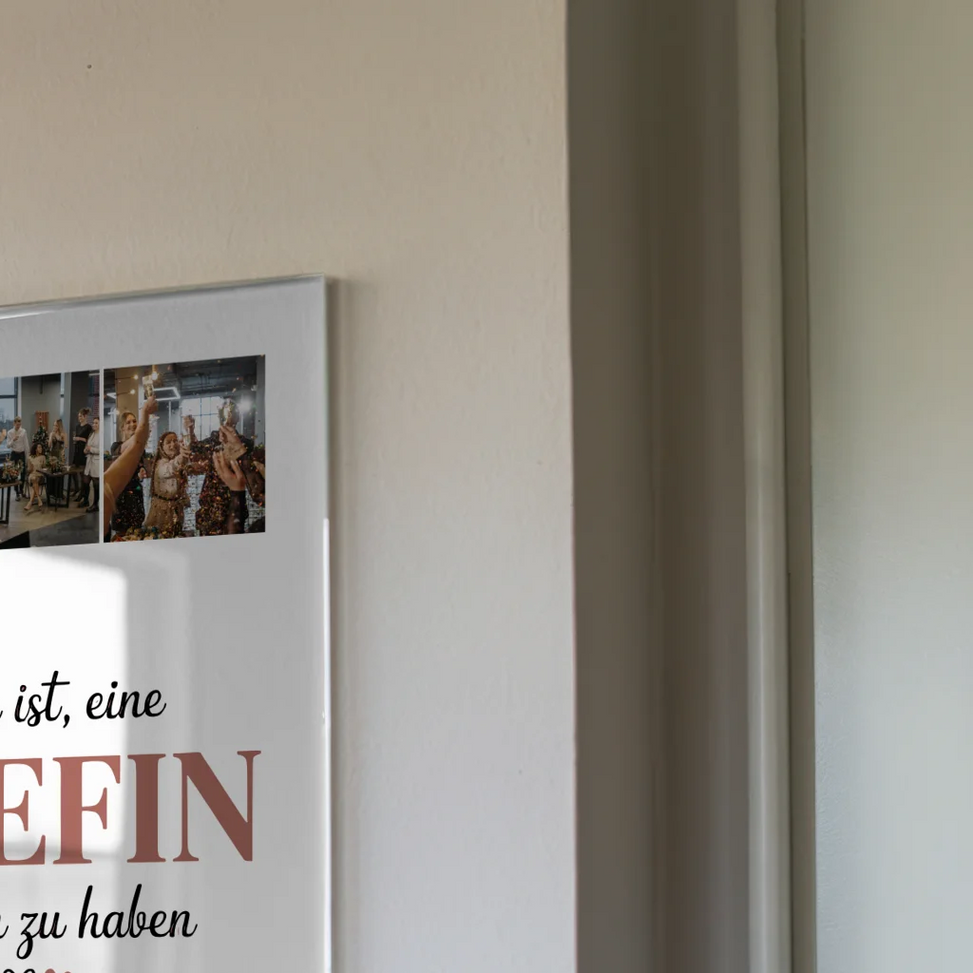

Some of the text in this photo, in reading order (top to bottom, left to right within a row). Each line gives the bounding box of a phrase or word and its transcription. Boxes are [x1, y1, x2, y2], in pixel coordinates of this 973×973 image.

[14, 670, 71, 729] ist,
[85, 680, 167, 720] eine
[16, 911, 68, 960] zu
[78, 883, 198, 939] haben
